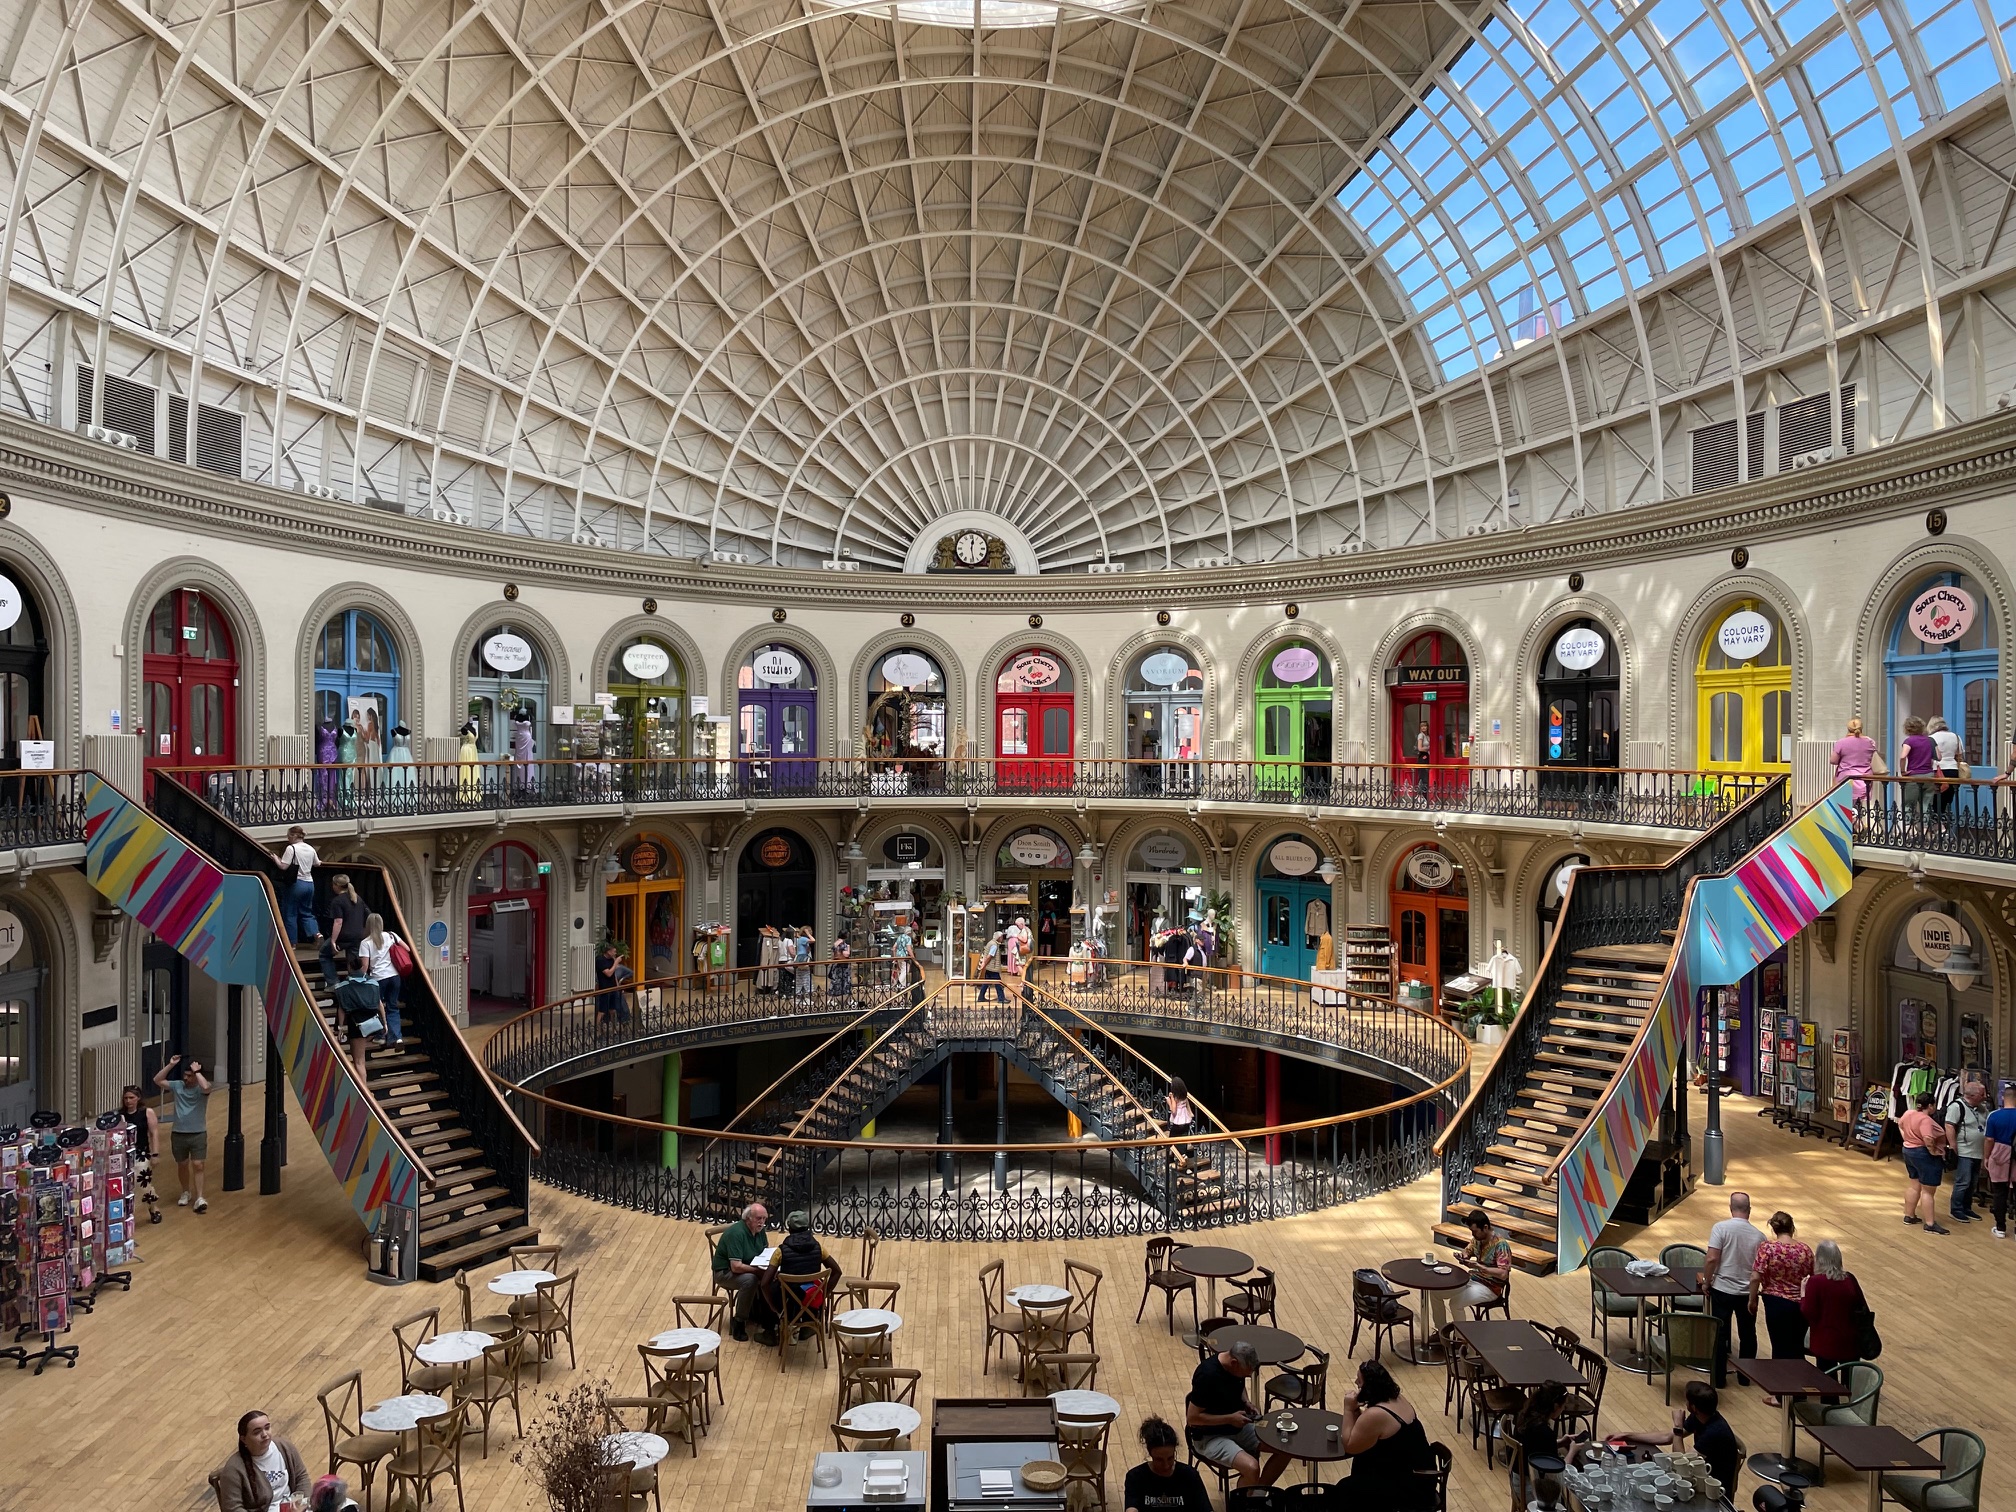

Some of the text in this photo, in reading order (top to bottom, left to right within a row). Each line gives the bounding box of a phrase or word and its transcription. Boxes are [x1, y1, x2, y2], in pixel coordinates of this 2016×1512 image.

[1928, 513, 1941, 529] 15
[1733, 551, 1744, 563] 16
[1570, 576, 1580, 587] 17
[506, 586, 518, 597] 24
[645, 601, 656, 611] 23
[1915, 590, 1967, 615] Sour Cherry
[774, 610, 785, 619] 22
[1287, 605, 1296, 615] 18
[902, 615, 913, 624] 21
[1030, 616, 1041, 625] 20
[1159, 613, 1169, 622] 19
[1723, 625, 1765, 637] COLOURS
[1919, 619, 1962, 641] Jewellery
[1560, 640, 1599, 650] COLOURS
[1724, 634, 1765, 646] MAY VARY
[493, 641, 522, 654] Precious
[1560, 648, 1598, 658] MAY VARY
[628, 652, 664, 661] evergreen
[633, 661, 658, 673] gallery
[762, 665, 792, 675] studios
[1016, 657, 1055, 672] Sour Cherry
[1019, 674, 1052, 686] Jewellery
[1409, 668, 1461, 681] WAY OUT
[1147, 845, 1179, 855] Wardrobe
[1414, 853, 1446, 865] HOUSEHOLD GOODS
[1417, 876, 1431, 885] VINTAGE
[1431, 876, 1447, 886] SUPPLIES
[1923, 929, 1951, 943] INDIE
[1924, 941, 1951, 951] MAKERS
[1087, 1013, 1105, 1023] OUR
[1107, 1014, 1128, 1024] PAST
[1130, 1016, 1163, 1028] SHAPES
[1165, 1021, 1182, 1030] OUR
[1184, 1023, 1215, 1035] FUTURE
[1220, 1027, 1245, 1039] BLOCK
[1247, 1031, 1258, 1040] BY
[1260, 1034, 1284, 1046] BLOCK
[1285, 1039, 1298, 1049] WE
[1300, 1041, 1320, 1054] BUILD
[583, 1056, 597, 1068] LIVE
[599, 1052, 613, 1063] YOU
[614, 1047, 629, 1059] CAN
[634, 1043, 650, 1054] CAN
[651, 1040, 663, 1050] WE
[665, 1037, 680, 1047] ALL
[701, 1031, 709, 1040] IT
[710, 1029, 726, 1039] ALL
[728, 1024, 758, 1036] STARTS
[760, 1022, 780, 1032] WITH
[782, 1019, 804, 1029] YOUR
[806, 1014, 858, 1027] IMAGINATION
[1870, 1097, 1886, 1105] INDIE
